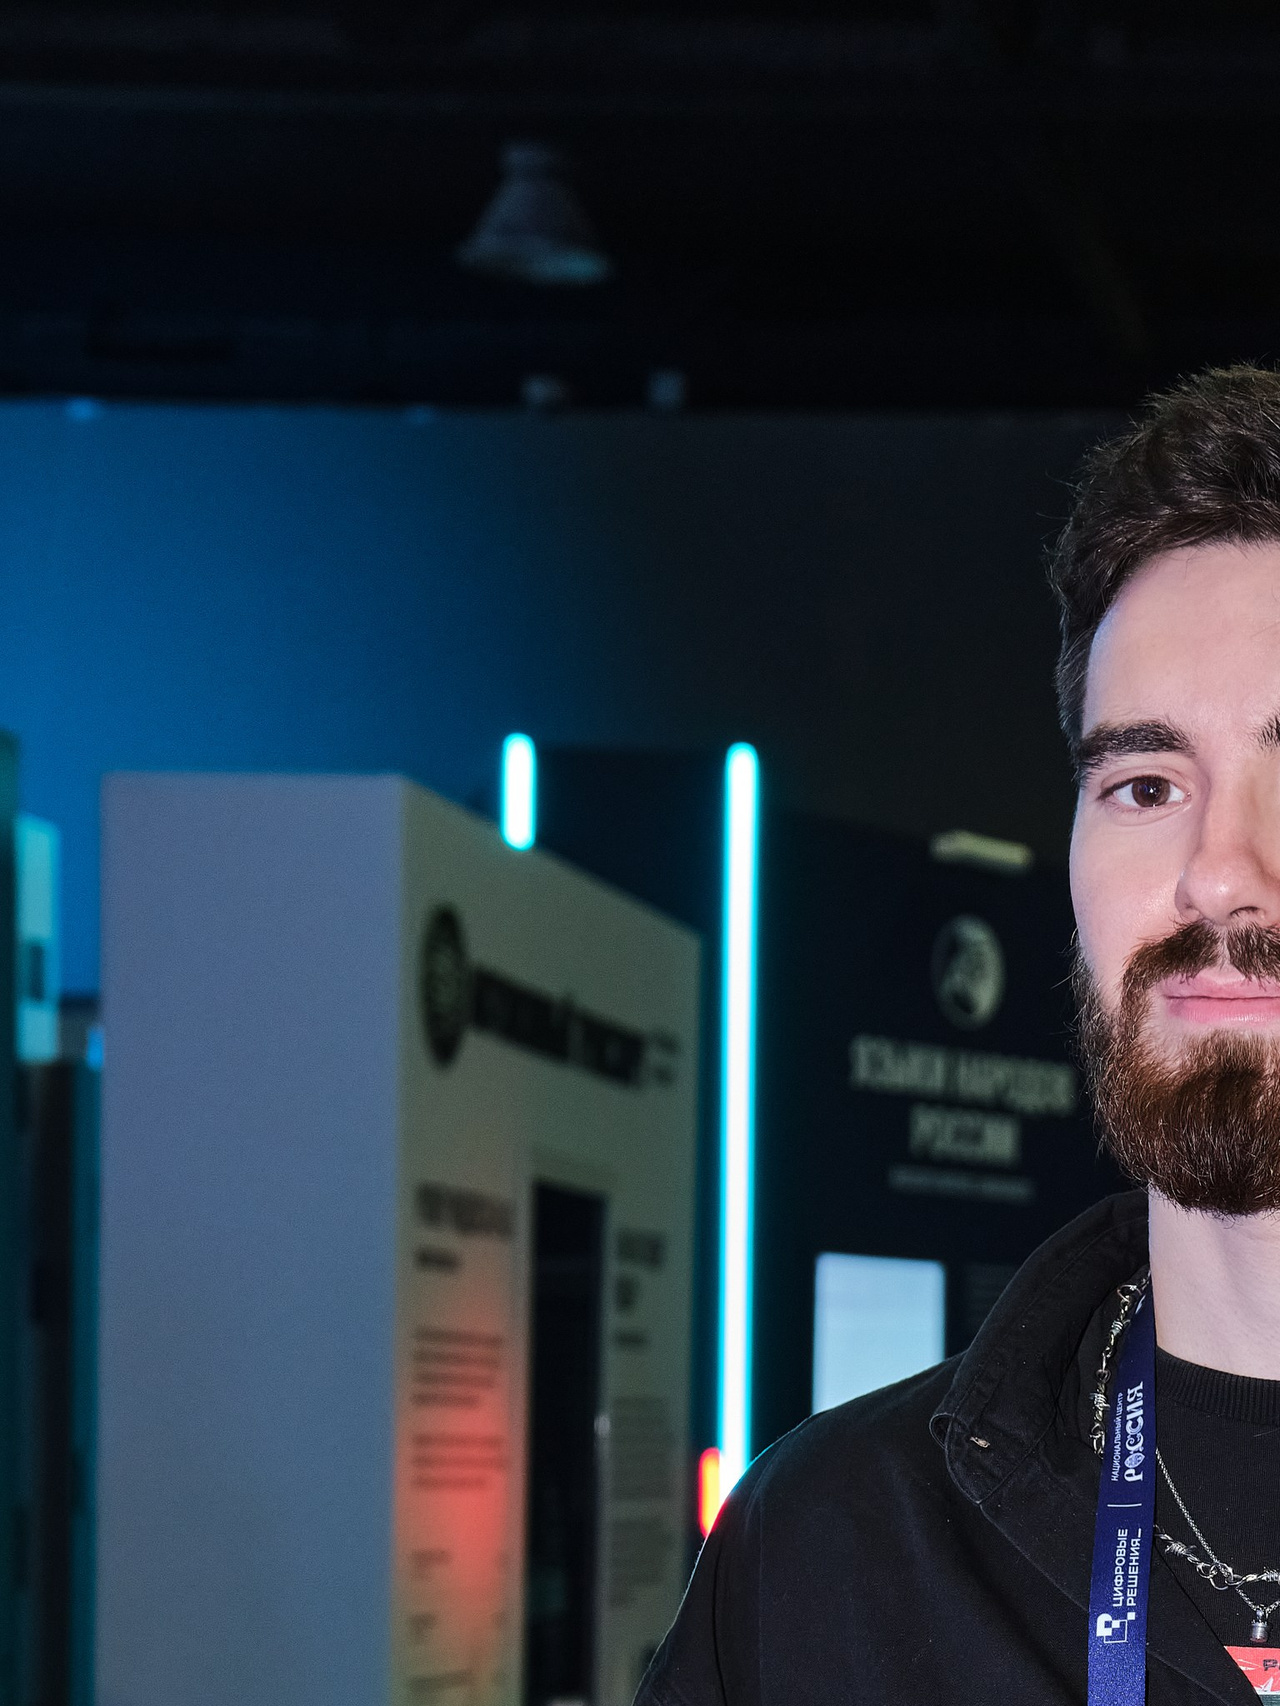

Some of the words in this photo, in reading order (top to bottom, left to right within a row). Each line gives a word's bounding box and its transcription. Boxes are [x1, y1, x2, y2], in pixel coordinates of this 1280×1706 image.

[1111, 1413, 1123, 1481] НАЦИОНАЛЬНЫЙ
[1124, 1381, 1144, 1483] РОССИЯ
[1113, 1528, 1129, 1607] ЦИФРОВЫЕ
